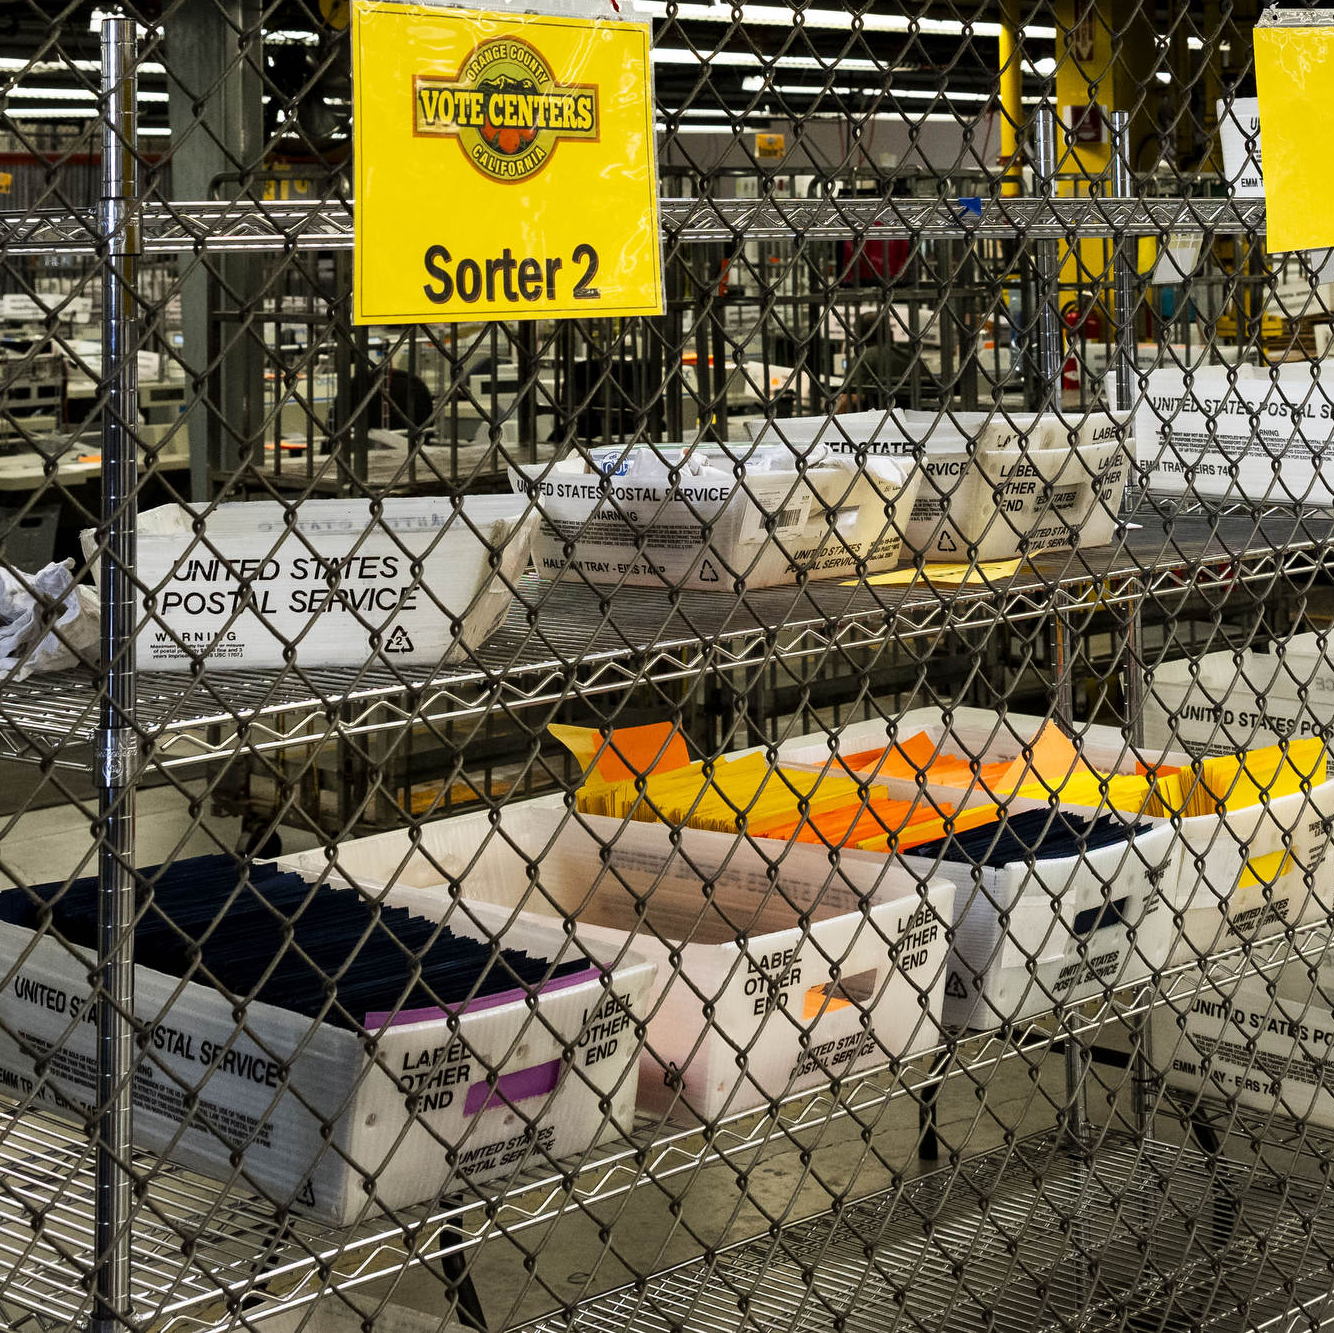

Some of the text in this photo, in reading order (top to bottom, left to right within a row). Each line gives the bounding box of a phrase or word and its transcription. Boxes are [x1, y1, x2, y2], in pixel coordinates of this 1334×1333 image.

[467, 43, 549, 85] ORANGE COUNTY
[419, 89, 592, 130] VOTE CENTERS
[472, 146, 547, 177] CALIFORNIA
[423, 244, 601, 304] Sorter 2
[1153, 397, 1199, 413] UNITED
[1202, 398, 1255, 415] STATES
[517, 480, 730, 502] UNED STATES POSTAL SERVICE
[172, 556, 399, 581] UNITED STATES
[585, 561, 610, 573] TRAY
[822, 556, 862, 569] SERVICE
[161, 587, 420, 616] POSTAL SERVICE
[901, 948, 929, 972] END
[15, 976, 67, 1014] UNITED
[199, 1040, 280, 1088] SERVICE
[577, 1015, 630, 1049] OTHER
[585, 1040, 618, 1067] END
[400, 1065, 471, 1092] OTHER
[1173, 1059, 1197, 1077] EMM
[415, 1091, 454, 1114] END
[457, 1141, 506, 1165] UNITED
